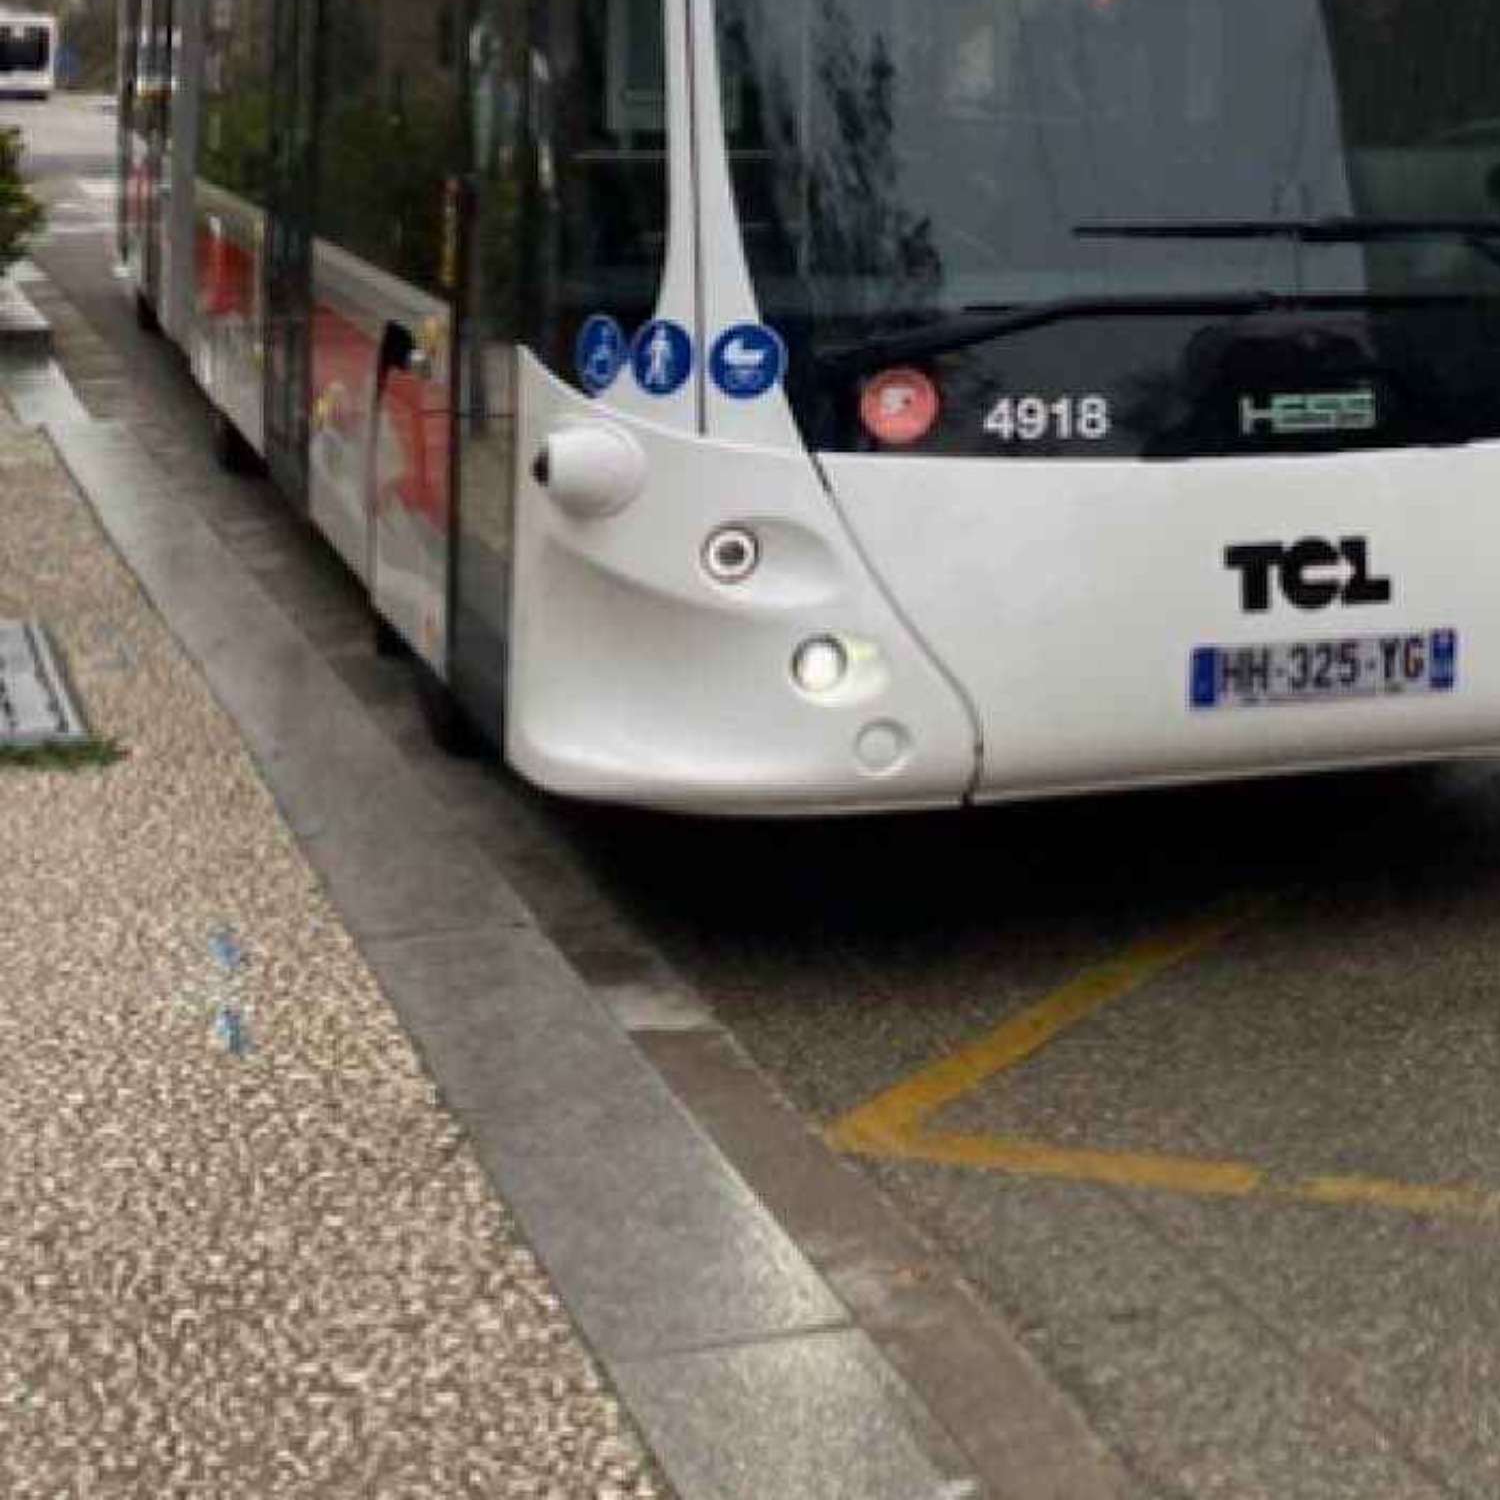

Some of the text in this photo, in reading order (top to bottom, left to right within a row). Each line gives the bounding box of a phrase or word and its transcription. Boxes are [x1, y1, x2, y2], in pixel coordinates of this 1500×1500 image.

[985, 397, 1108, 439] 4918
[1240, 392, 1376, 435] HESS
[1224, 536, 1391, 612] TCL
[1222, 635, 1424, 695] HH-325-YG
